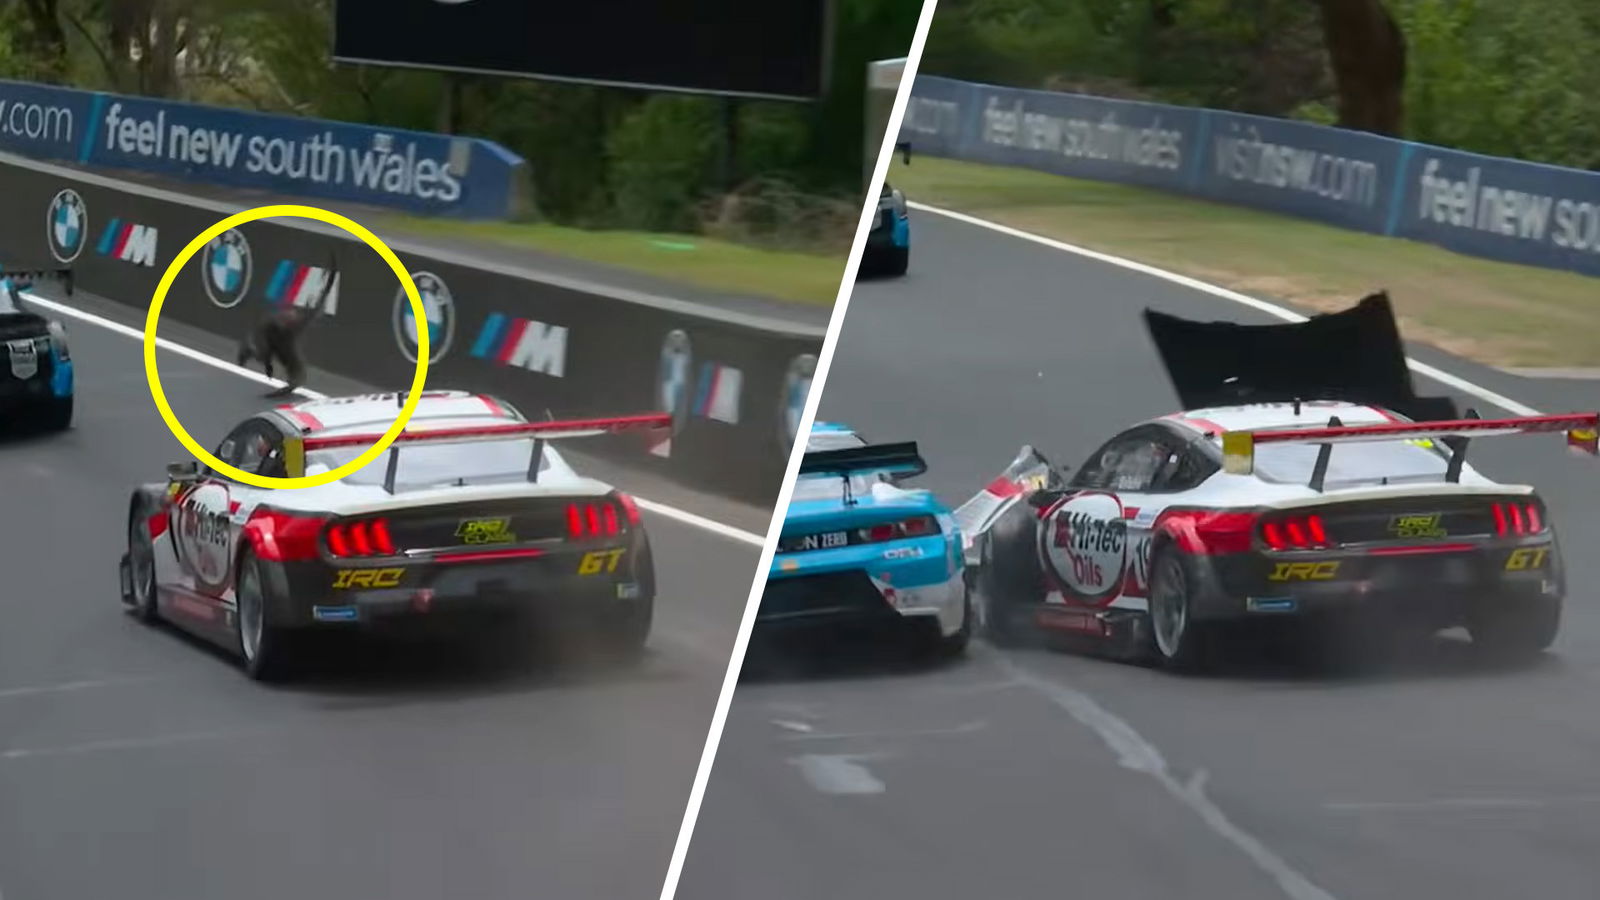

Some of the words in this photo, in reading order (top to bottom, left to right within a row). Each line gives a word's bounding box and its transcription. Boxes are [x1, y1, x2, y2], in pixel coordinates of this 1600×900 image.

[0, 100, 74, 143] .com
[106, 103, 165, 157] feel
[169, 123, 243, 168] new
[246, 131, 345, 184] south
[351, 142, 462, 201] wales
[1419, 158, 1481, 229] feel
[1476, 185, 1552, 240] new
[821, 531, 848, 547] ZERO
[1072, 512, 1121, 554] Hi-Tec
[578, 549, 626, 575] GT
[1073, 554, 1103, 588] Oils
[1268, 560, 1341, 581] IRC
[1505, 547, 1551, 571] GT
[331, 567, 406, 588] IRC
